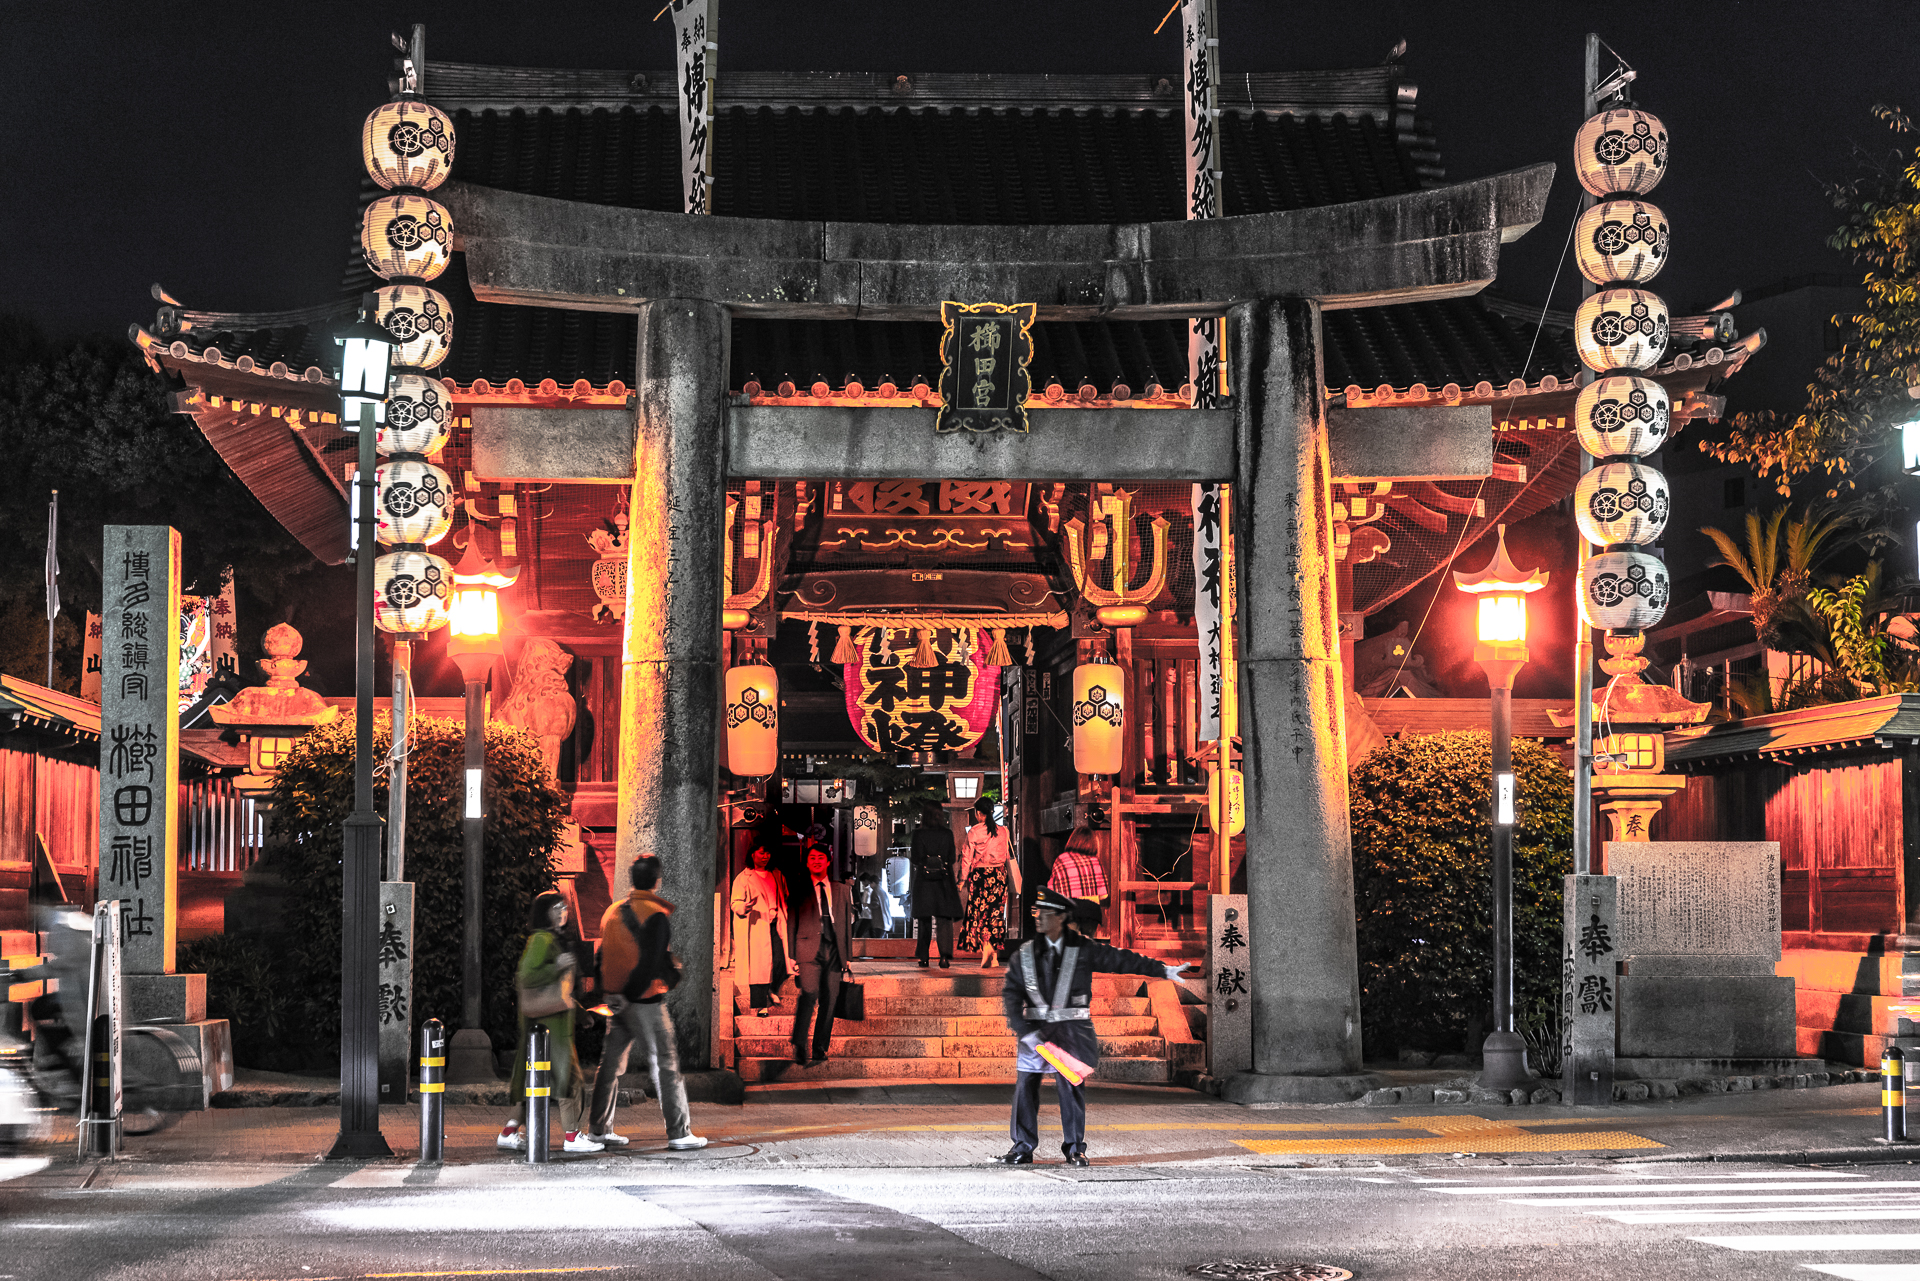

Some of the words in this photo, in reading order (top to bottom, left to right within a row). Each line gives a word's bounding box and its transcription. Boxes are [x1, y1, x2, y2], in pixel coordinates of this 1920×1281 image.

[968, 321, 1001, 406] 櫛田宮
[214, 598, 232, 639] 奉納
[109, 724, 155, 947] 櫛田神社
[1625, 814, 1646, 837] 奉
